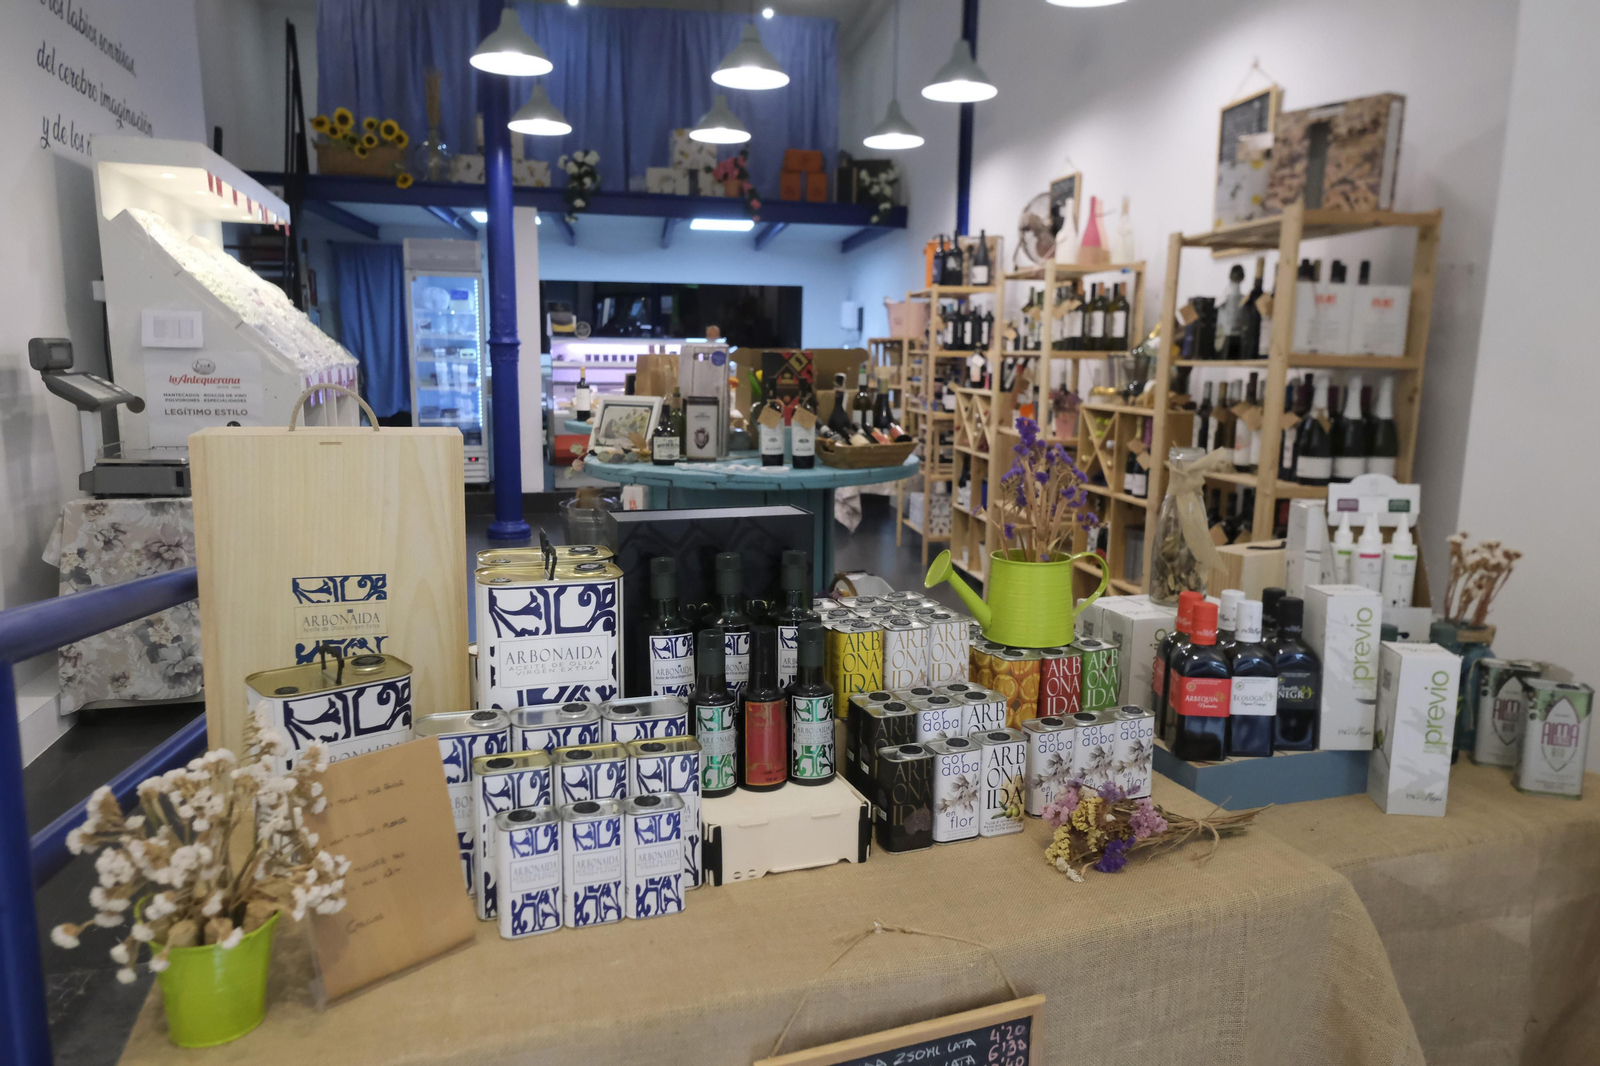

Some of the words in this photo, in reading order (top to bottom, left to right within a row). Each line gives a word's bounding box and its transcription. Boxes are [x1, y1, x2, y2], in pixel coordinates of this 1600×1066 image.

[37, 40, 55, 76] del
[58, 67, 98, 102] cerebro
[40, 116, 50, 149] y
[53, 113, 67, 145] de
[70, 120, 84, 153] los
[176, 374, 241, 387] Antequerana
[164, 407, 212, 416] LEGÍTIMO
[214, 408, 248, 416] ESTILO
[302, 612, 381, 628] ARBONAIDA
[843, 630, 882, 653] ARB
[893, 630, 929, 650] ARB
[932, 621, 967, 643] ARB
[931, 641, 967, 663] ONA
[1351, 607, 1374, 681] previo
[505, 645, 603, 666] ARBONAIDA
[508, 662, 547, 672] ACEITE
[552, 661, 564, 669] DE
[569, 659, 601, 667] OLIVA
[842, 651, 880, 673] ONA
[892, 649, 927, 669] ONA
[1087, 648, 1119, 672] ARB
[515, 668, 556, 677] VIRGEN
[561, 664, 595, 673] EXTRA
[656, 666, 692, 677] ARBONAIDA
[931, 661, 966, 683] IDA
[1047, 655, 1081, 678] ARB
[843, 672, 880, 693] IDA
[892, 668, 926, 690] IDA
[1046, 675, 1080, 697] ONA
[1086, 668, 1118, 690] ONA
[1047, 694, 1080, 716] IDA
[1086, 686, 1117, 708] IDA
[922, 709, 947, 722] cor
[968, 701, 1005, 725] ARB
[1424, 671, 1449, 745] previo
[875, 715, 915, 738] ARB
[922, 718, 960, 732] doba
[1082, 725, 1105, 738] cor
[1120, 719, 1142, 732] cor
[1120, 726, 1153, 741] doba
[1038, 732, 1062, 744] cor
[1038, 740, 1073, 754] doba
[1082, 733, 1115, 747] doba
[941, 753, 967, 766] cor
[988, 744, 1026, 769] ARB
[893, 758, 934, 783] ARB
[941, 762, 980, 777] doba
[986, 765, 1024, 788] ONA
[892, 779, 932, 804] ONA
[987, 786, 1024, 810] IDA
[950, 816, 974, 829] flor
[576, 855, 619, 871] ARBONAIDA
[638, 849, 680, 864] ARBONAIDA
[513, 860, 558, 877] ARBONAIDA
[947, 1038, 977, 1053] LATA
[989, 1024, 1026, 1043] 4'20
